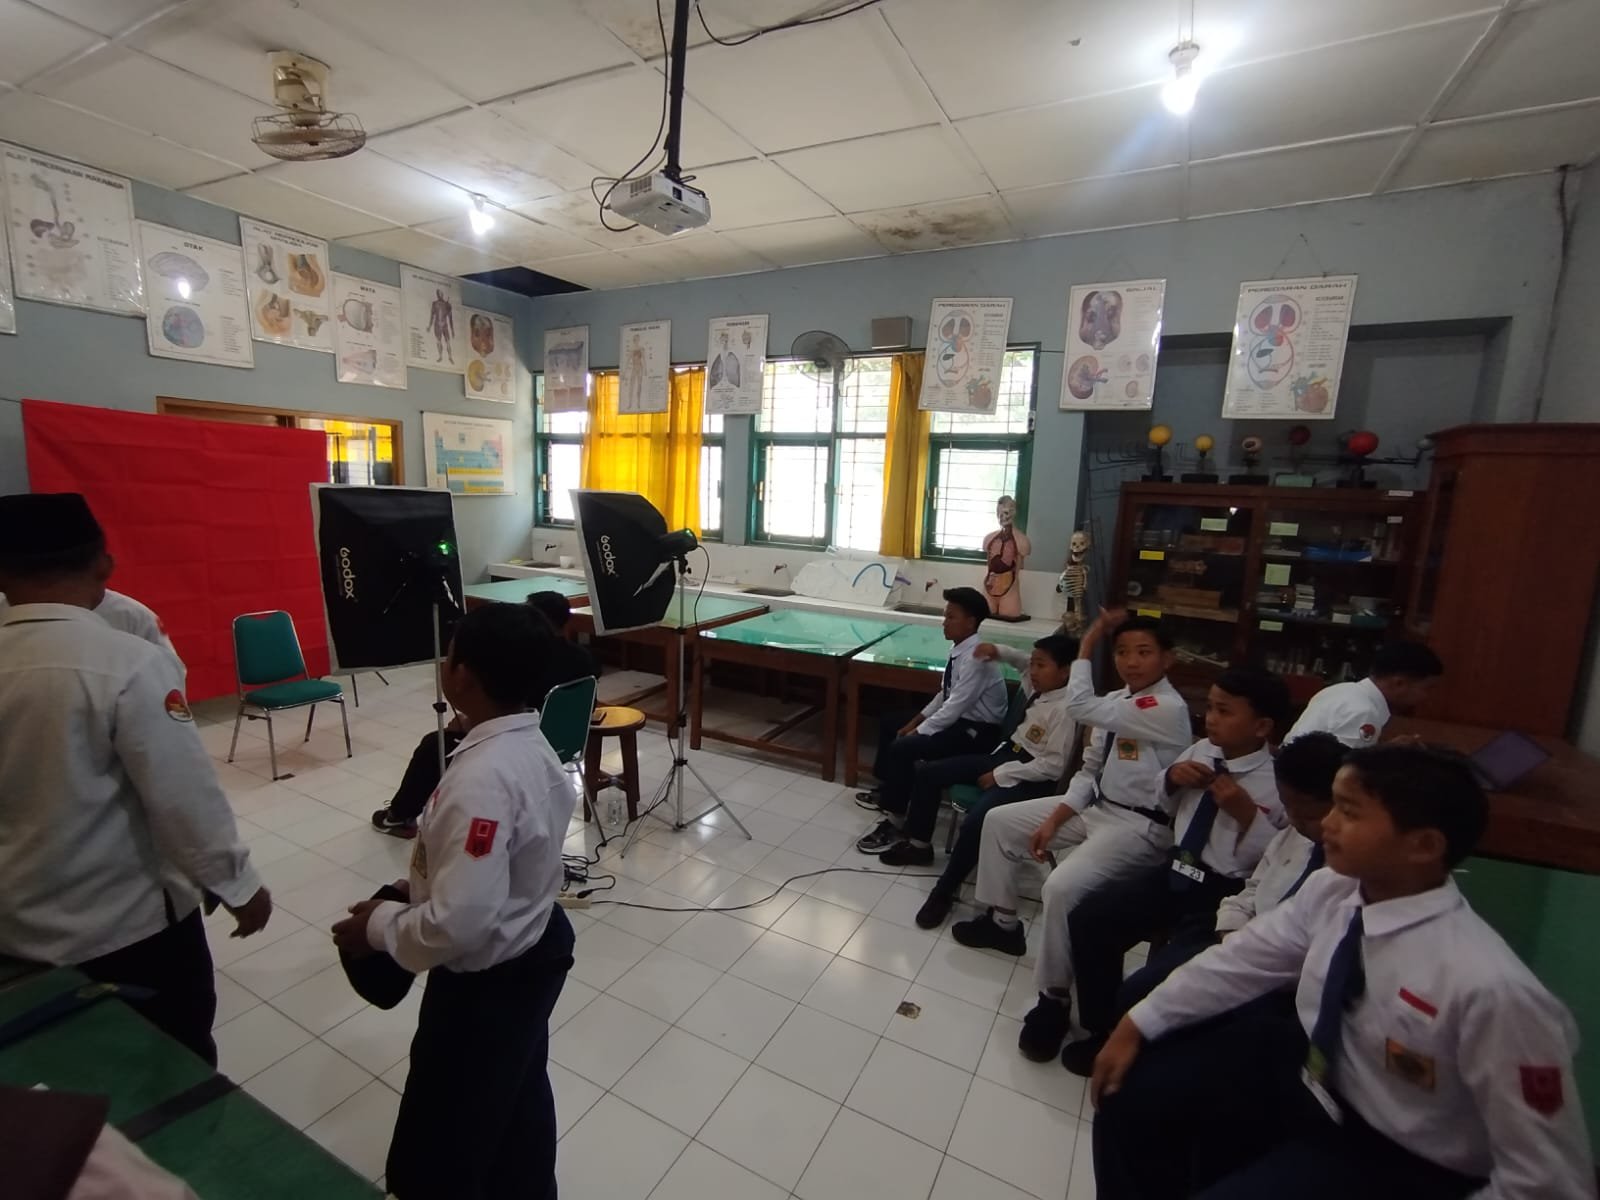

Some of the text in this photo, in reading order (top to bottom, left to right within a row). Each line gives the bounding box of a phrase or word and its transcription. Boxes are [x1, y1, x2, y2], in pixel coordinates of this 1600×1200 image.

[183, 241, 205, 252] OTAK
[599, 534, 617, 576] Godox
[339, 546, 357, 600] Godox
[1189, 867, 1202, 880] 23
